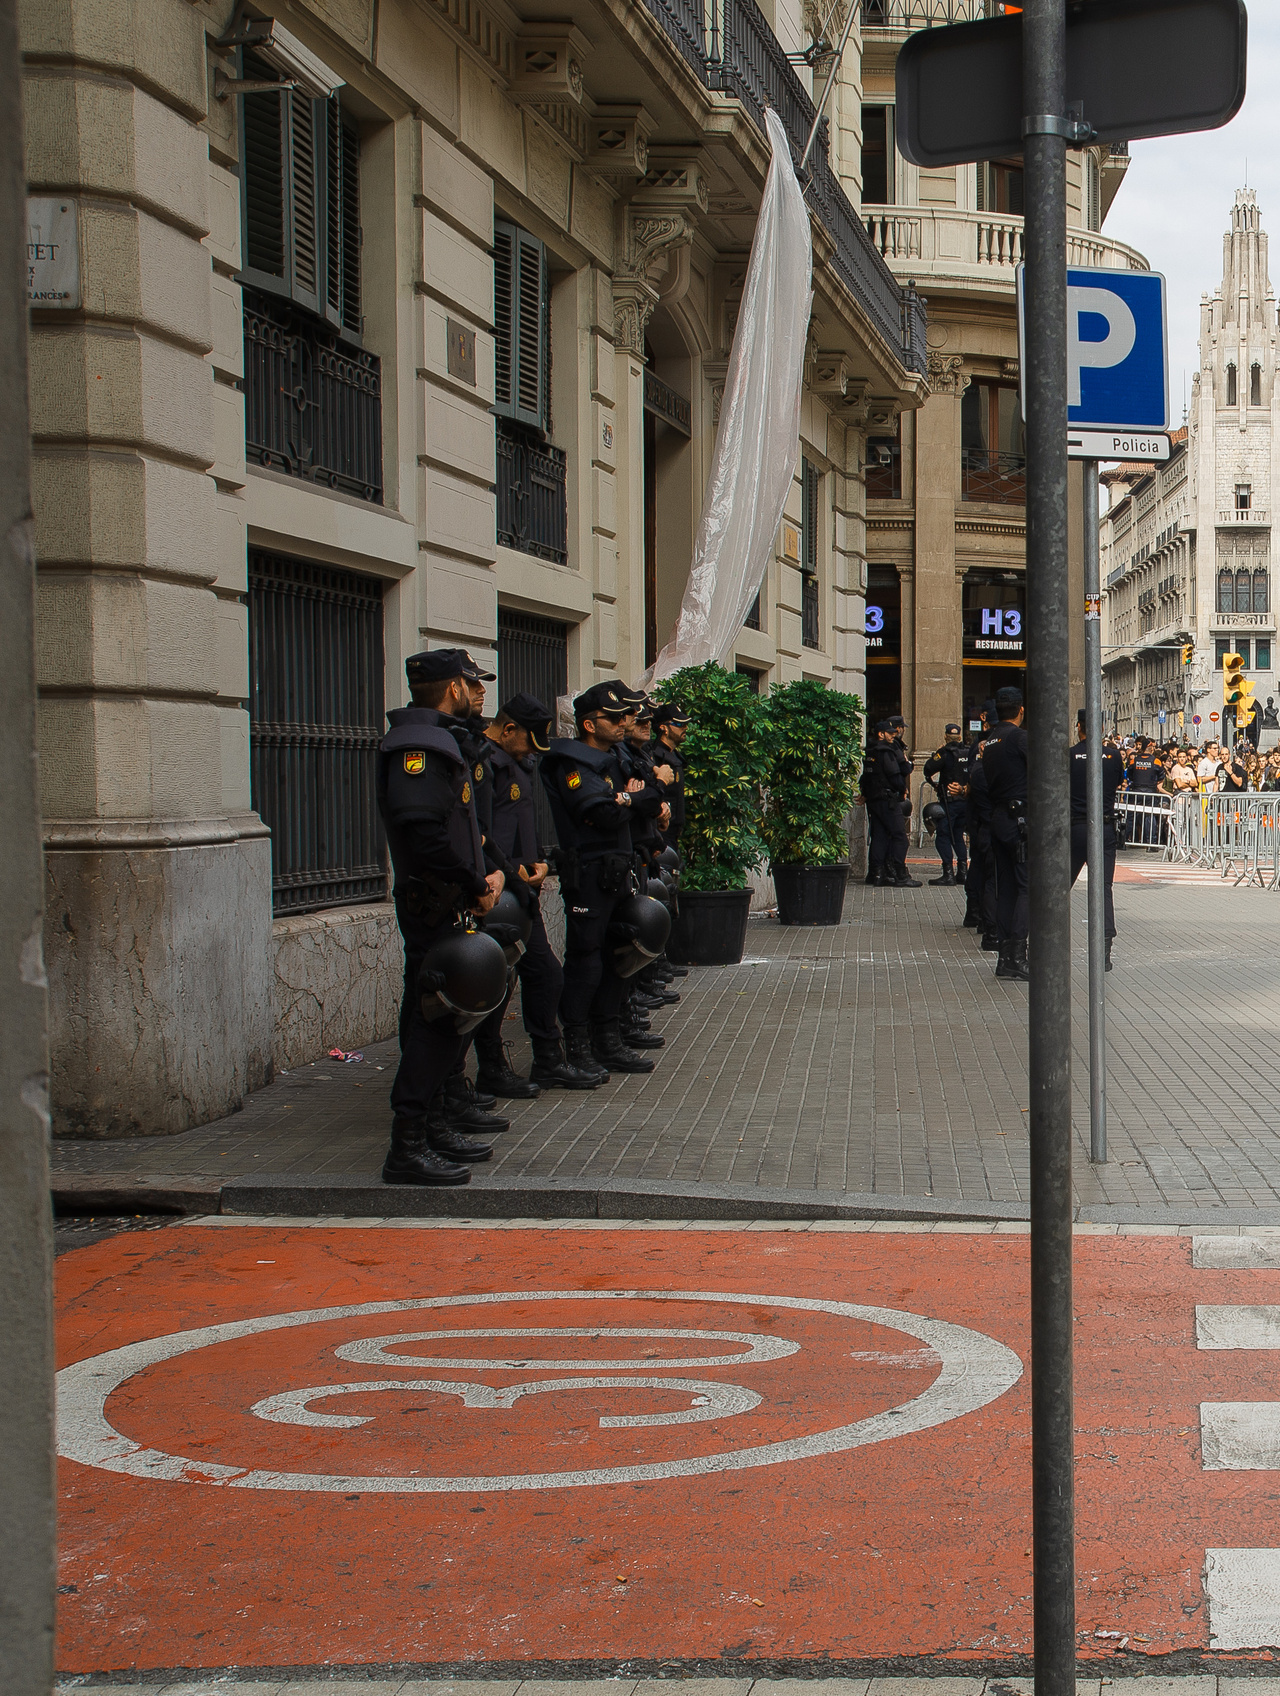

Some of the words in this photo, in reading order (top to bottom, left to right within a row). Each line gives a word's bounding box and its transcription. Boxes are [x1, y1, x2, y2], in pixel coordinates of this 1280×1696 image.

[1067, 286, 1136, 407] P
[1113, 438, 1159, 453] Policia
[981, 608, 1022, 636] H3
[865, 638, 883, 647] BAR
[975, 640, 1023, 650] RESTAURANT
